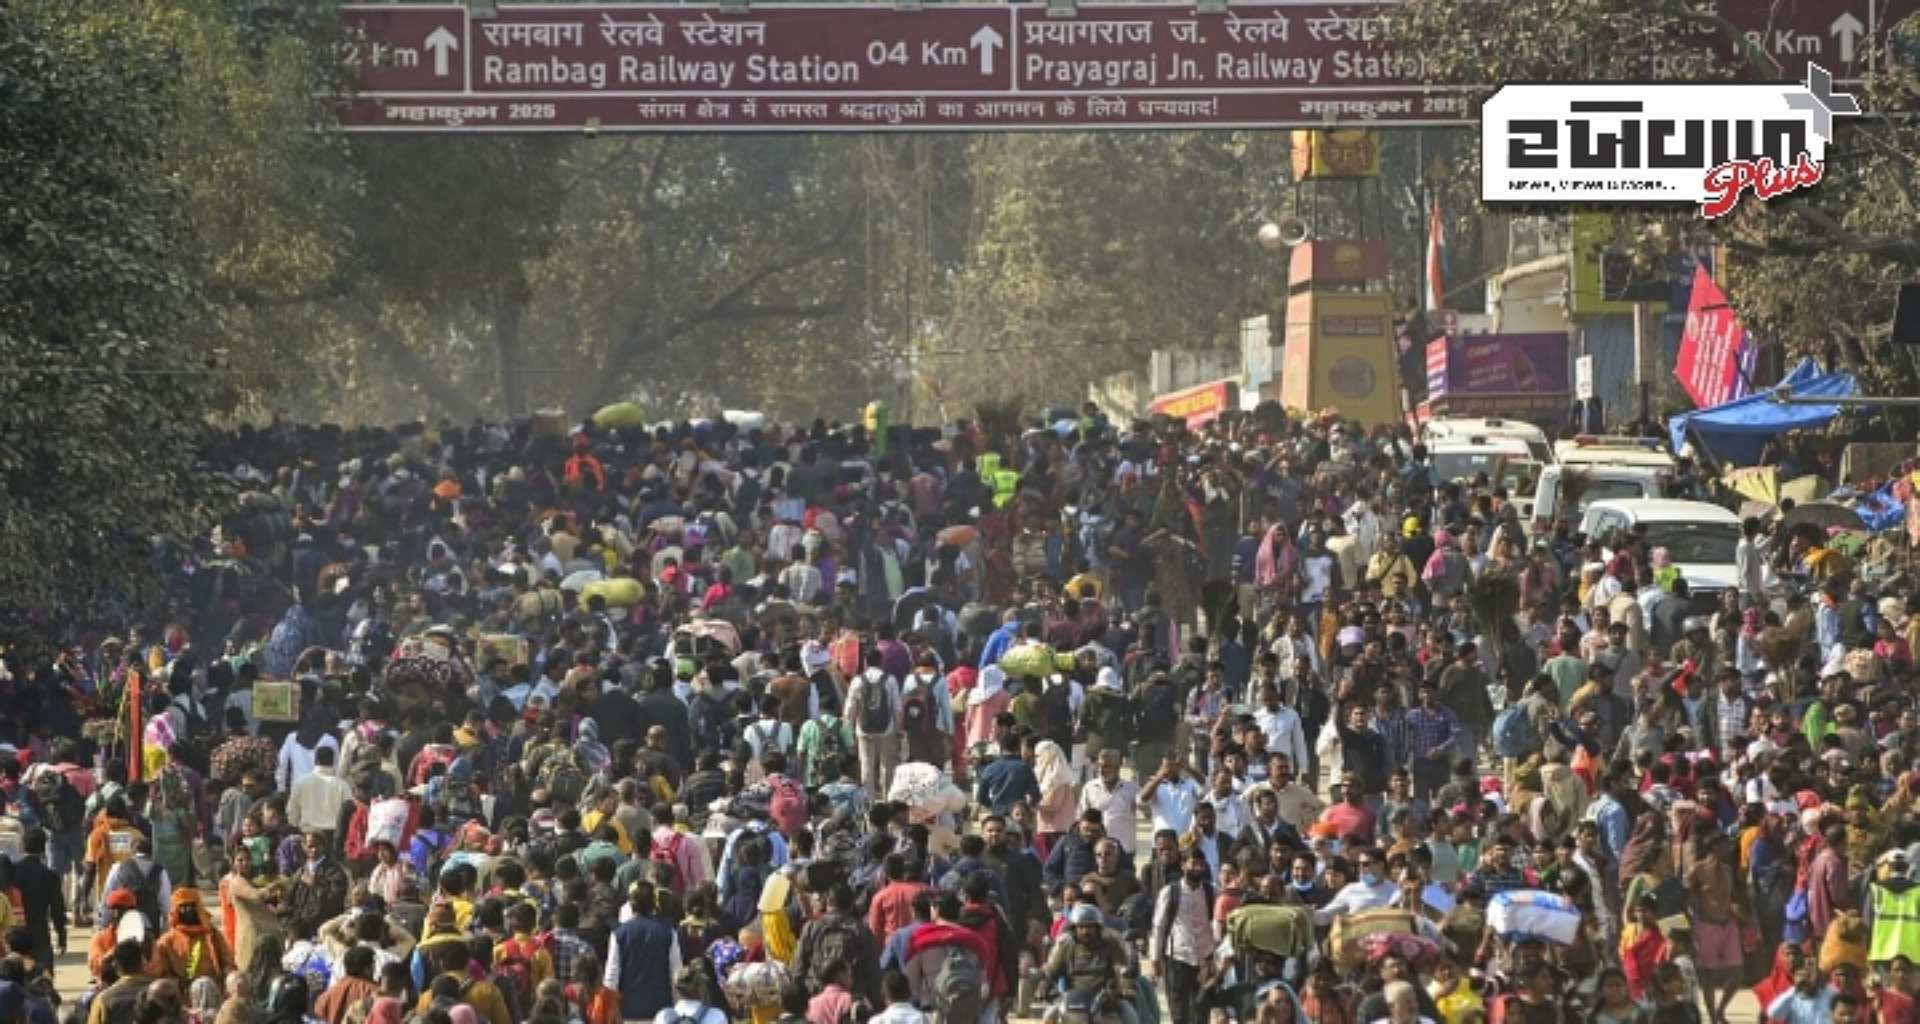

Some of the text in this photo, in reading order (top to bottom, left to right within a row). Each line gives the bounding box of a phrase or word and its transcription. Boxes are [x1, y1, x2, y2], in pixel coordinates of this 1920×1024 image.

[482, 13, 766, 46] रामबाग रेलवे स्टेशन
[1024, 20, 1151, 44] प्रयागराज
[1224, 9, 1290, 43] रेलवे
[866, 41, 967, 65] 04 Km
[1775, 29, 1821, 55] Km
[484, 55, 859, 88] Rambag Railway Station
[1026, 54, 1157, 86] Prayagraj
[1167, 52, 1204, 81] Jn.
[1217, 51, 1323, 84] Railway
[509, 104, 556, 119] 2025
[638, 98, 686, 119] संगम
[696, 98, 729, 119] क्षेत्र
[741, 97, 757, 119] में
[769, 102, 827, 119] समस्त
[938, 101, 963, 118] का
[974, 101, 1044, 118] आगमन
[1055, 97, 1075, 117] के
[1087, 97, 1127, 117] लिये
